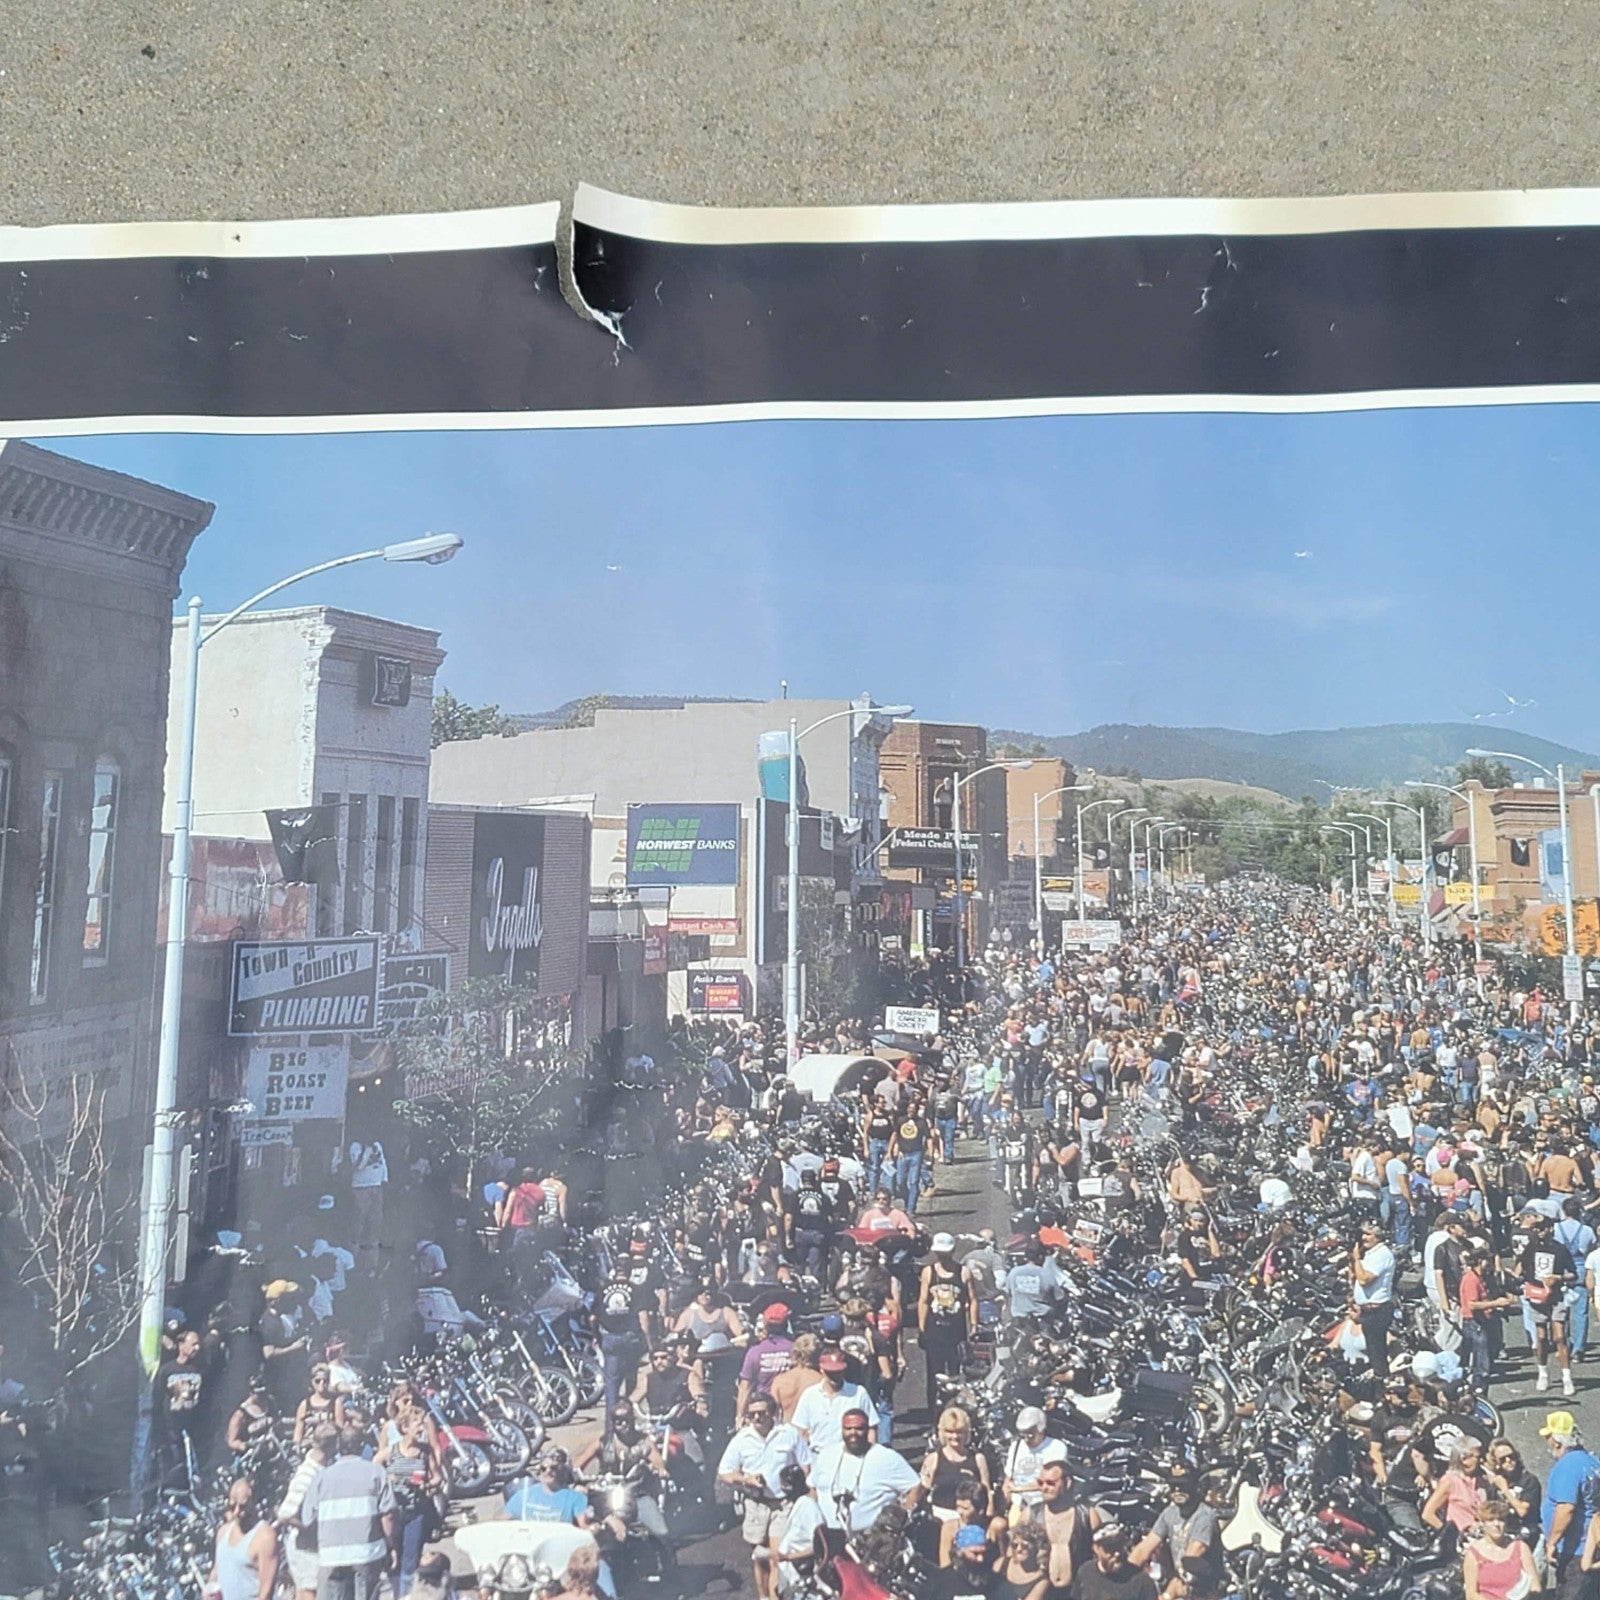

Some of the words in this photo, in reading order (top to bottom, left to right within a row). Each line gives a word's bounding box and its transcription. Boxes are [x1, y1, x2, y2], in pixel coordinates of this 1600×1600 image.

[904, 830, 940, 839] Meade
[636, 840, 695, 850] NORWEST
[697, 840, 736, 850] BANKS
[896, 838, 926, 848] Federal
[927, 840, 953, 850] Credit
[670, 921, 700, 930] Instant
[701, 921, 724, 930] Cash
[241, 948, 288, 979] Town
[292, 948, 358, 986] Country
[715, 974, 738, 984] Bank
[260, 995, 370, 1028] PLUMBING
[896, 1009, 936, 1018] AMERICAN
[269, 1052, 307, 1073] BIG
[266, 1073, 327, 1094] ROAST
[264, 1096, 315, 1116] BEEF
